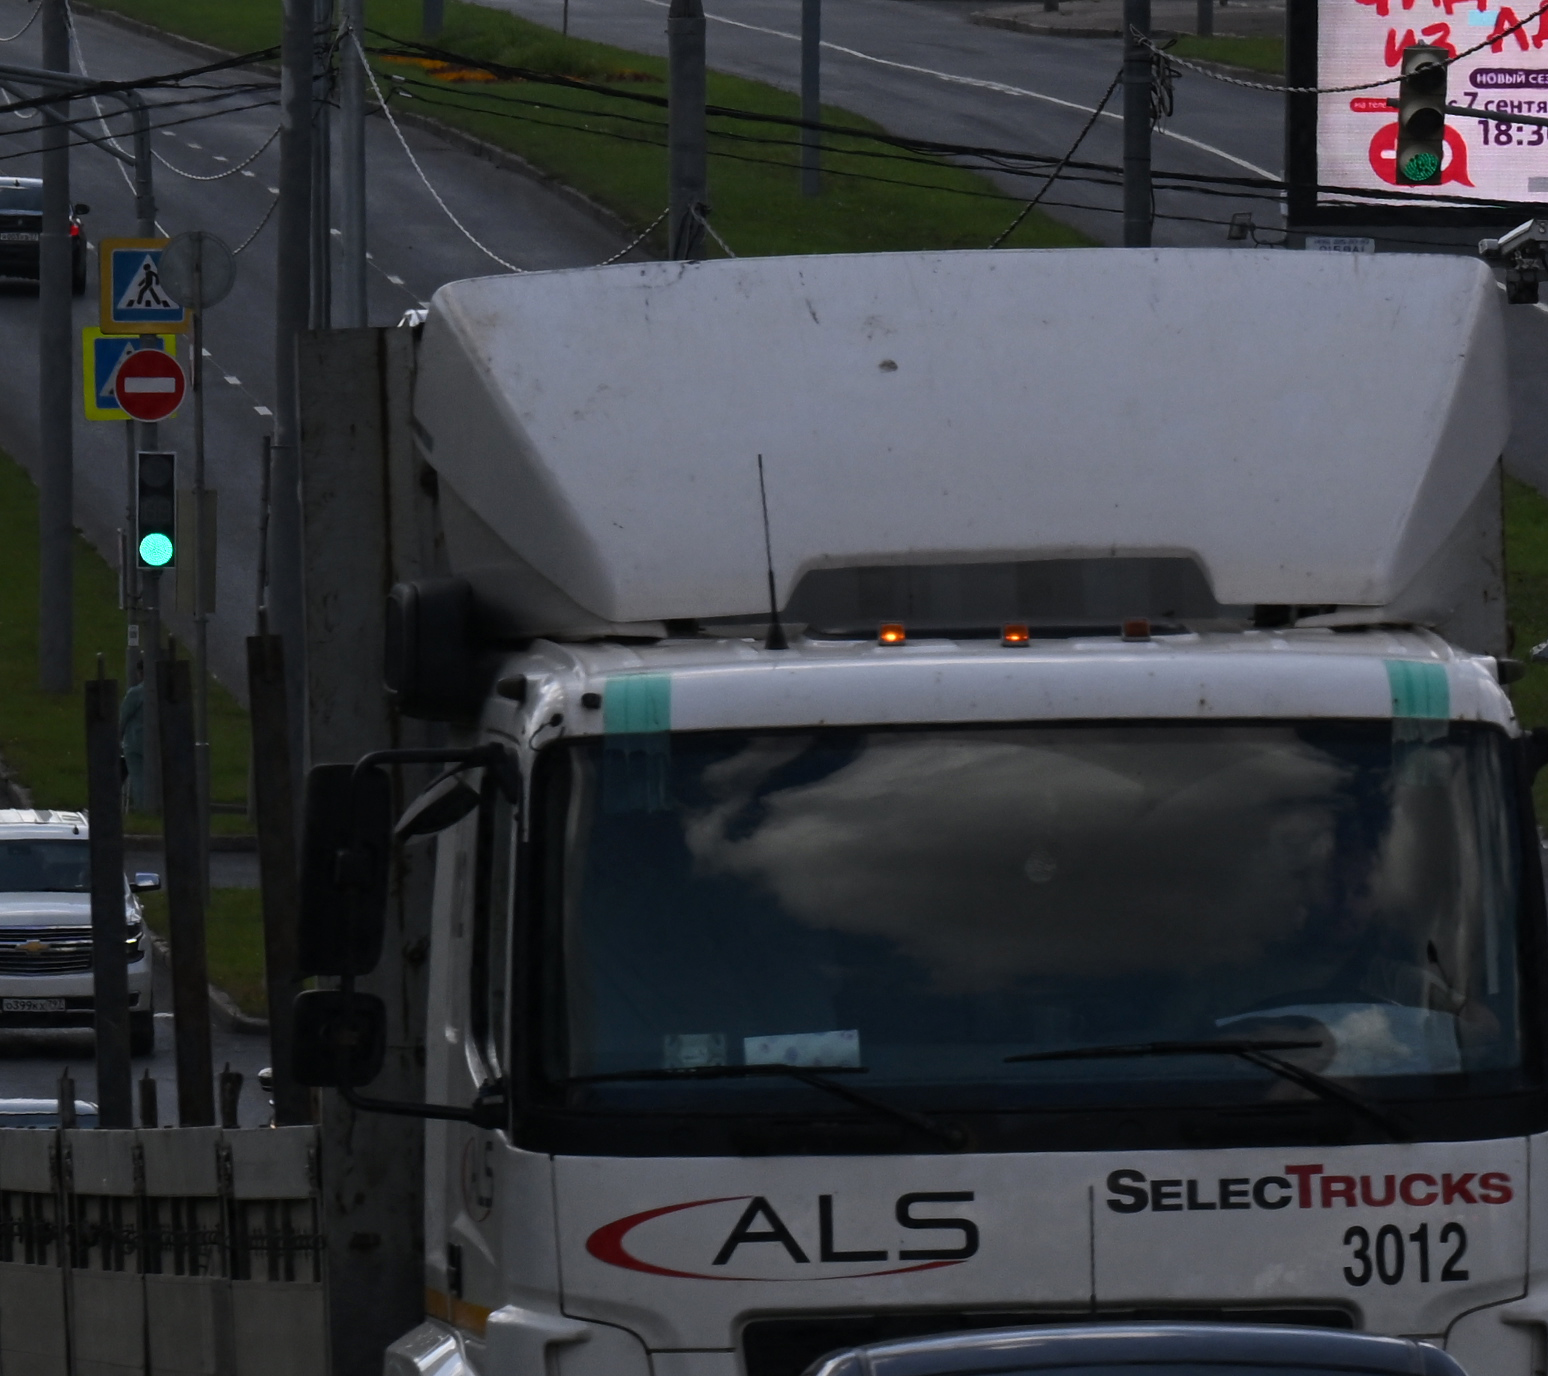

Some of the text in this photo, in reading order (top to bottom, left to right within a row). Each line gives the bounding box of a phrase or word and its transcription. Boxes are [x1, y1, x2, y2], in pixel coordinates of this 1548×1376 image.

[1476, 71, 1526, 85] НОВЫЙ
[1463, 92, 1480, 109] 7
[712, 1191, 979, 1266] ALS
[1341, 1222, 1469, 1287] 3012
